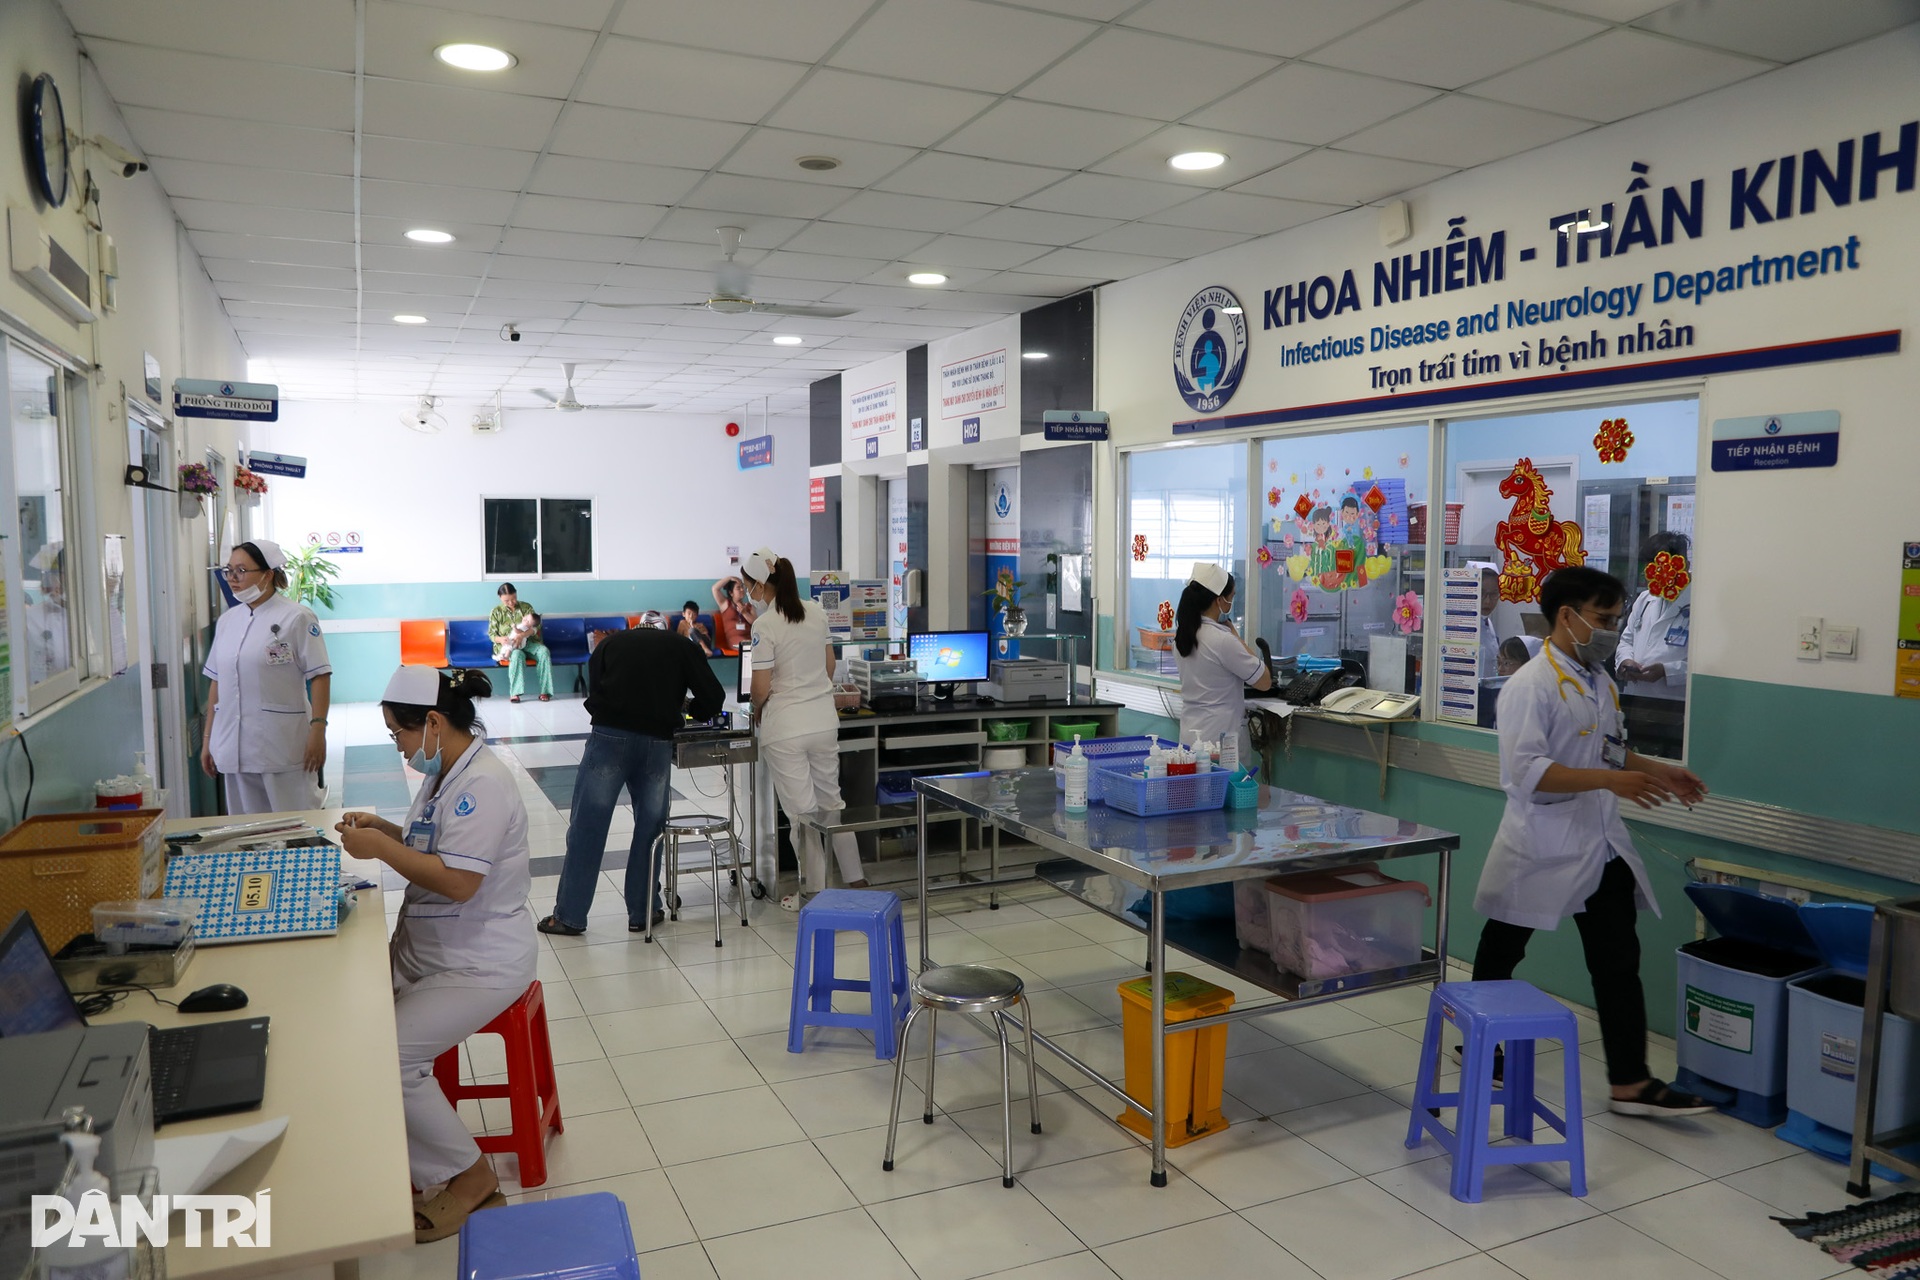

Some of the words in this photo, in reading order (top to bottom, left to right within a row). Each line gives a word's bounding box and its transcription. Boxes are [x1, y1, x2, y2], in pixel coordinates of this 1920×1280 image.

[1263, 269, 1362, 330] KHOA
[1373, 215, 1506, 308] NHIỄM
[1549, 161, 1704, 268] THẦN
[1730, 120, 1920, 231] KINH
[1186, 294, 1208, 318] VIỆN
[1208, 291, 1225, 304] NHI
[1280, 334, 1364, 368] Infectious
[1370, 321, 1450, 353] Disease
[1456, 304, 1499, 338] and
[1507, 283, 1644, 329] Neurology
[1652, 235, 1860, 305] Department
[1369, 365, 1412, 393] Trọn
[1418, 353, 1455, 382] trái
[1462, 349, 1500, 377] tim
[1509, 341, 1532, 370] vì
[1538, 330, 1606, 371] bệnh
[1617, 319, 1694, 356] nhân
[184, 395, 221, 408] PHÒNG
[1196, 394, 1220, 410] 1956
[1051, 423, 1063, 433] TIẾP
[1065, 425, 1084, 434] NHẬN
[1085, 425, 1102, 435] BỆNH
[1727, 443, 1751, 457] TIẾP
[1753, 442, 1785, 457] NHẬN
[1788, 440, 1821, 455] BỆNH
[254, 462, 273, 471] PHÒNG
[1753, 458, 1789, 467] Reception
[245, 877, 263, 907] 05.10
